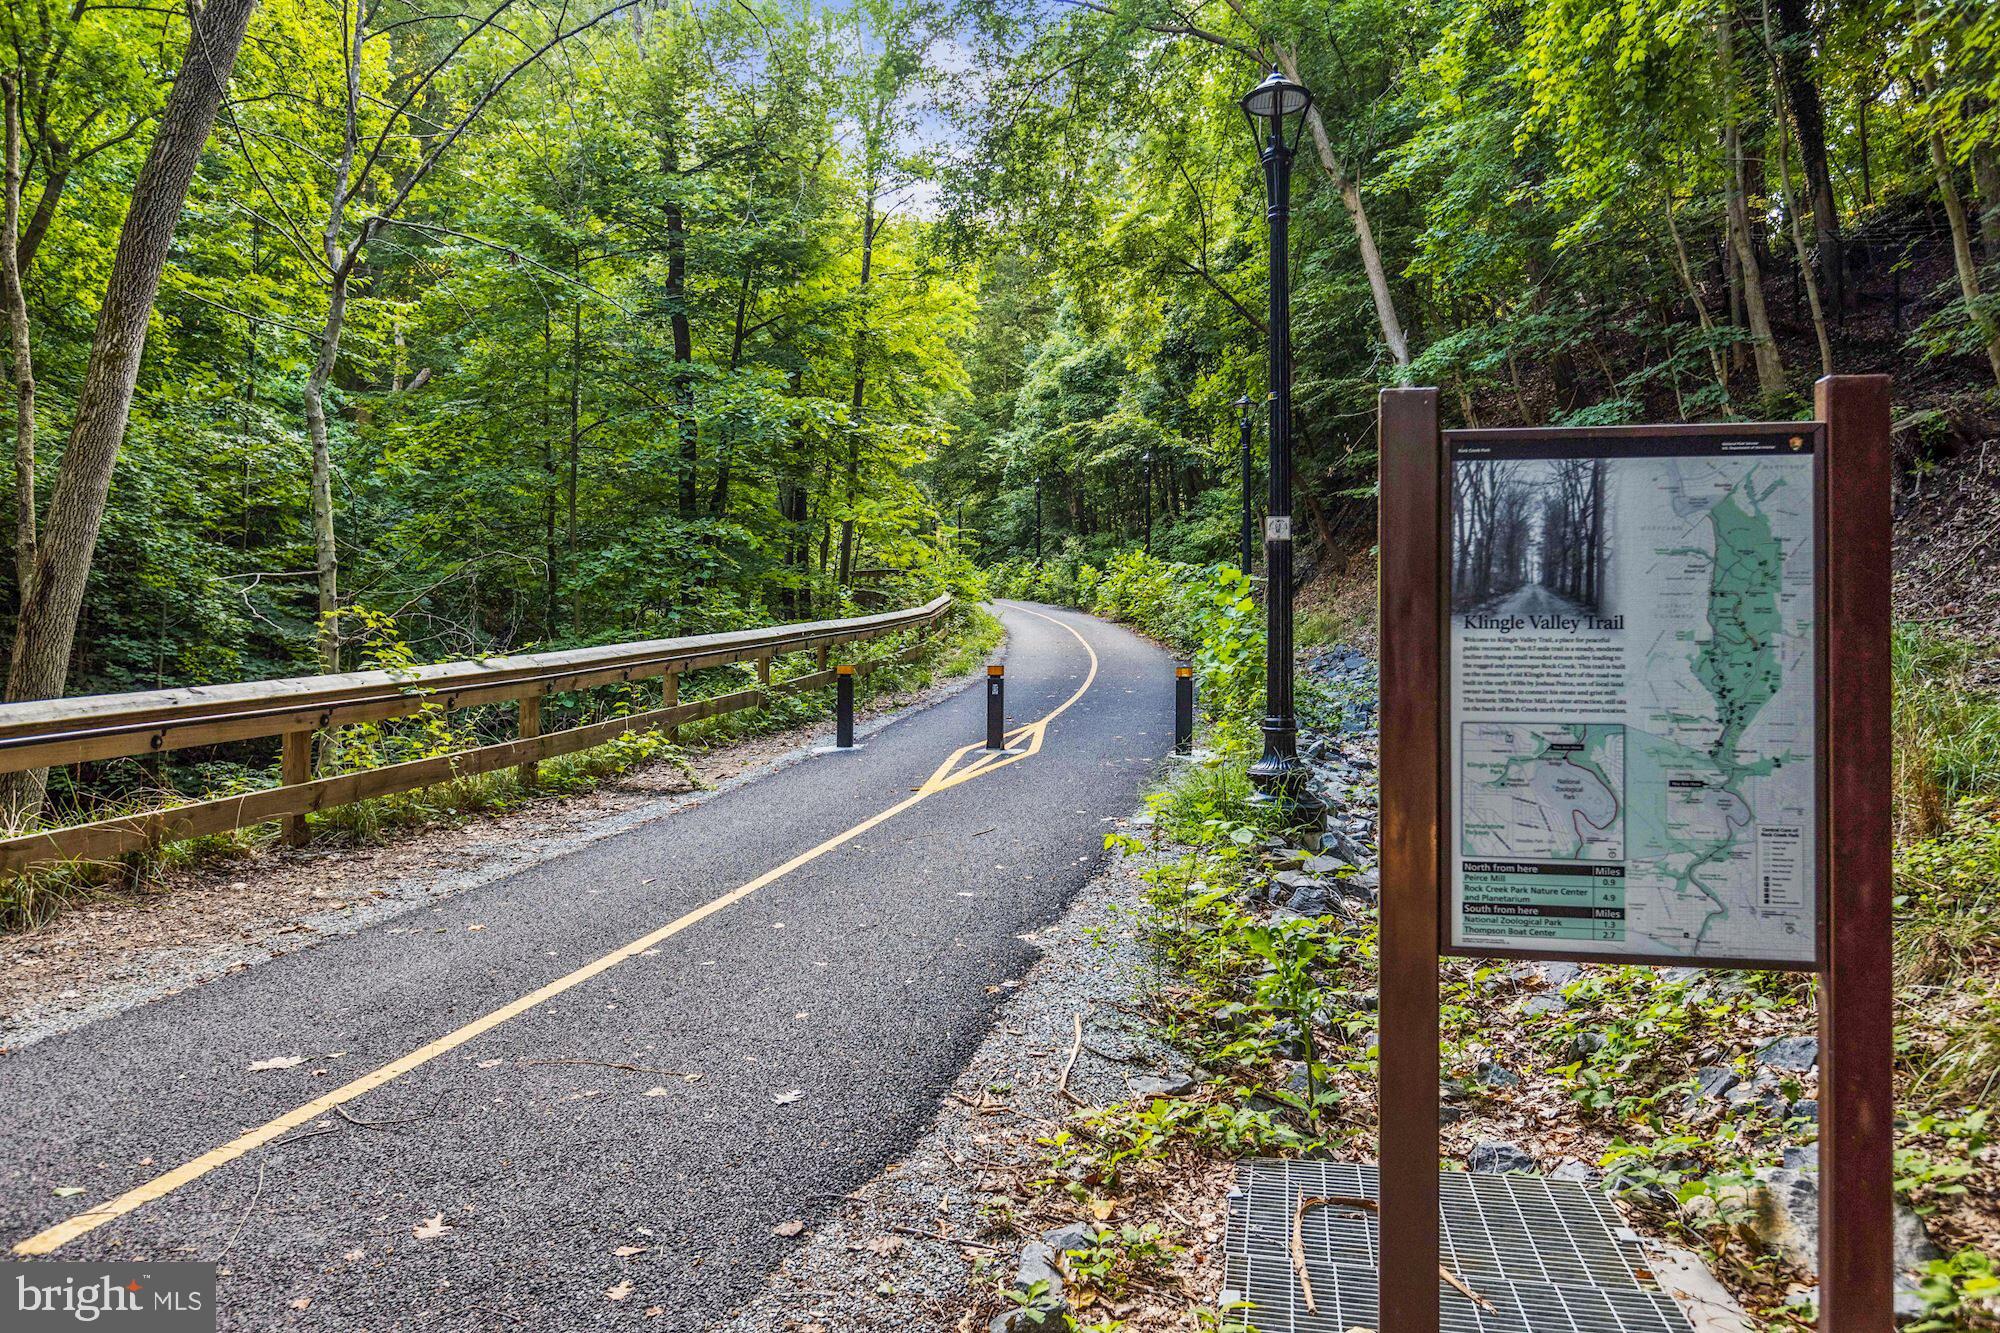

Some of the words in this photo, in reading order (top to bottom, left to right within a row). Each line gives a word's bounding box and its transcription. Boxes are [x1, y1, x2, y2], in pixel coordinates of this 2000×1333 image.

[1464, 615, 1525, 633] Klingle
[1528, 616, 1580, 634] Valley
[1582, 615, 1624, 630] Trail
[1464, 863, 1491, 872] North
[1493, 864, 1515, 872] from
[1517, 864, 1538, 873] here
[1464, 904, 1491, 913] South
[1494, 906, 1515, 914] from
[1517, 906, 1539, 915] here
[1595, 910, 1620, 918] Miles
[1500, 917, 1542, 926] Zoological
[1464, 926, 1506, 936] Thompson
